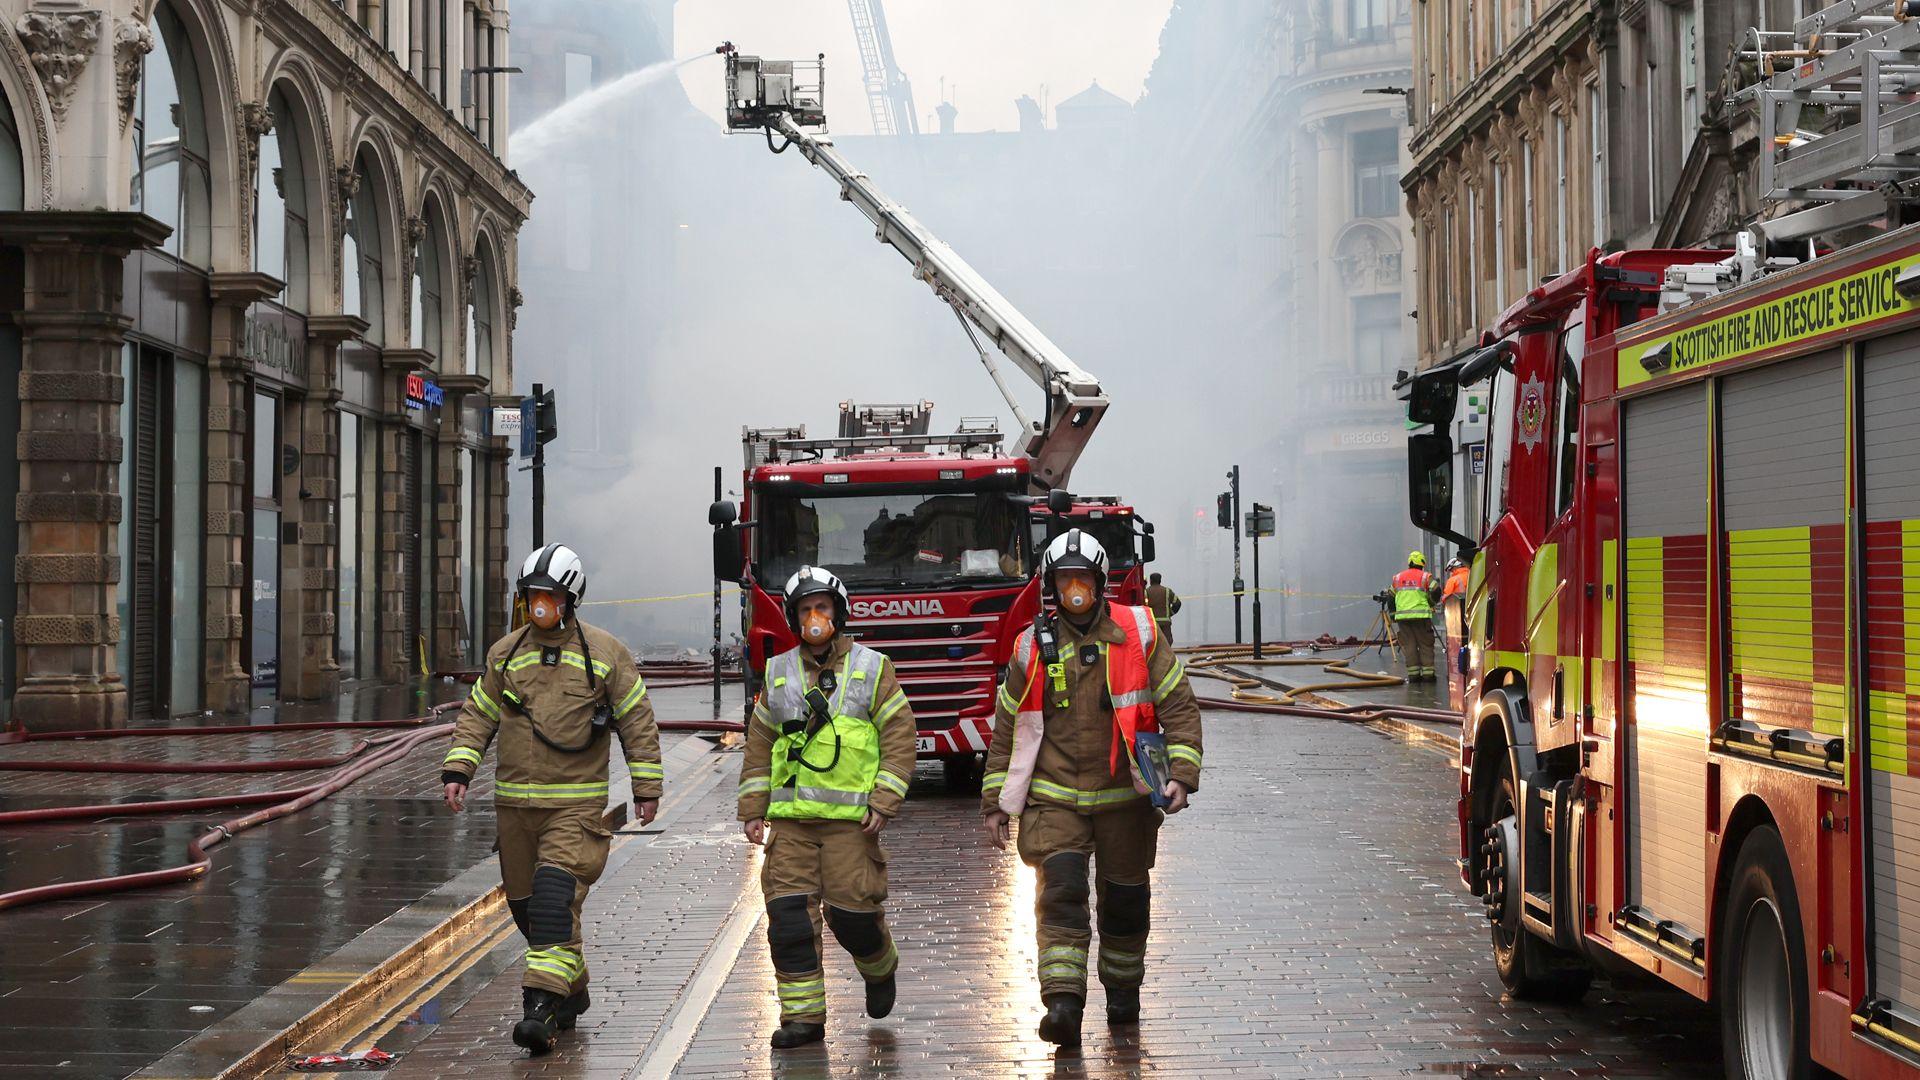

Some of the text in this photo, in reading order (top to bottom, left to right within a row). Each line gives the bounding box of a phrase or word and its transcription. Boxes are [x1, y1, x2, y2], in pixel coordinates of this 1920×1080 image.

[1675, 266, 1901, 369] SCOTTISH FIRE AND RESCUE SERVICE
[407, 374, 424, 400] TESCO
[501, 413, 520, 421] TESC
[1342, 431, 1390, 445] GREGGS
[852, 599, 945, 618] SCANIA
[842, 631, 864, 639] mergency
